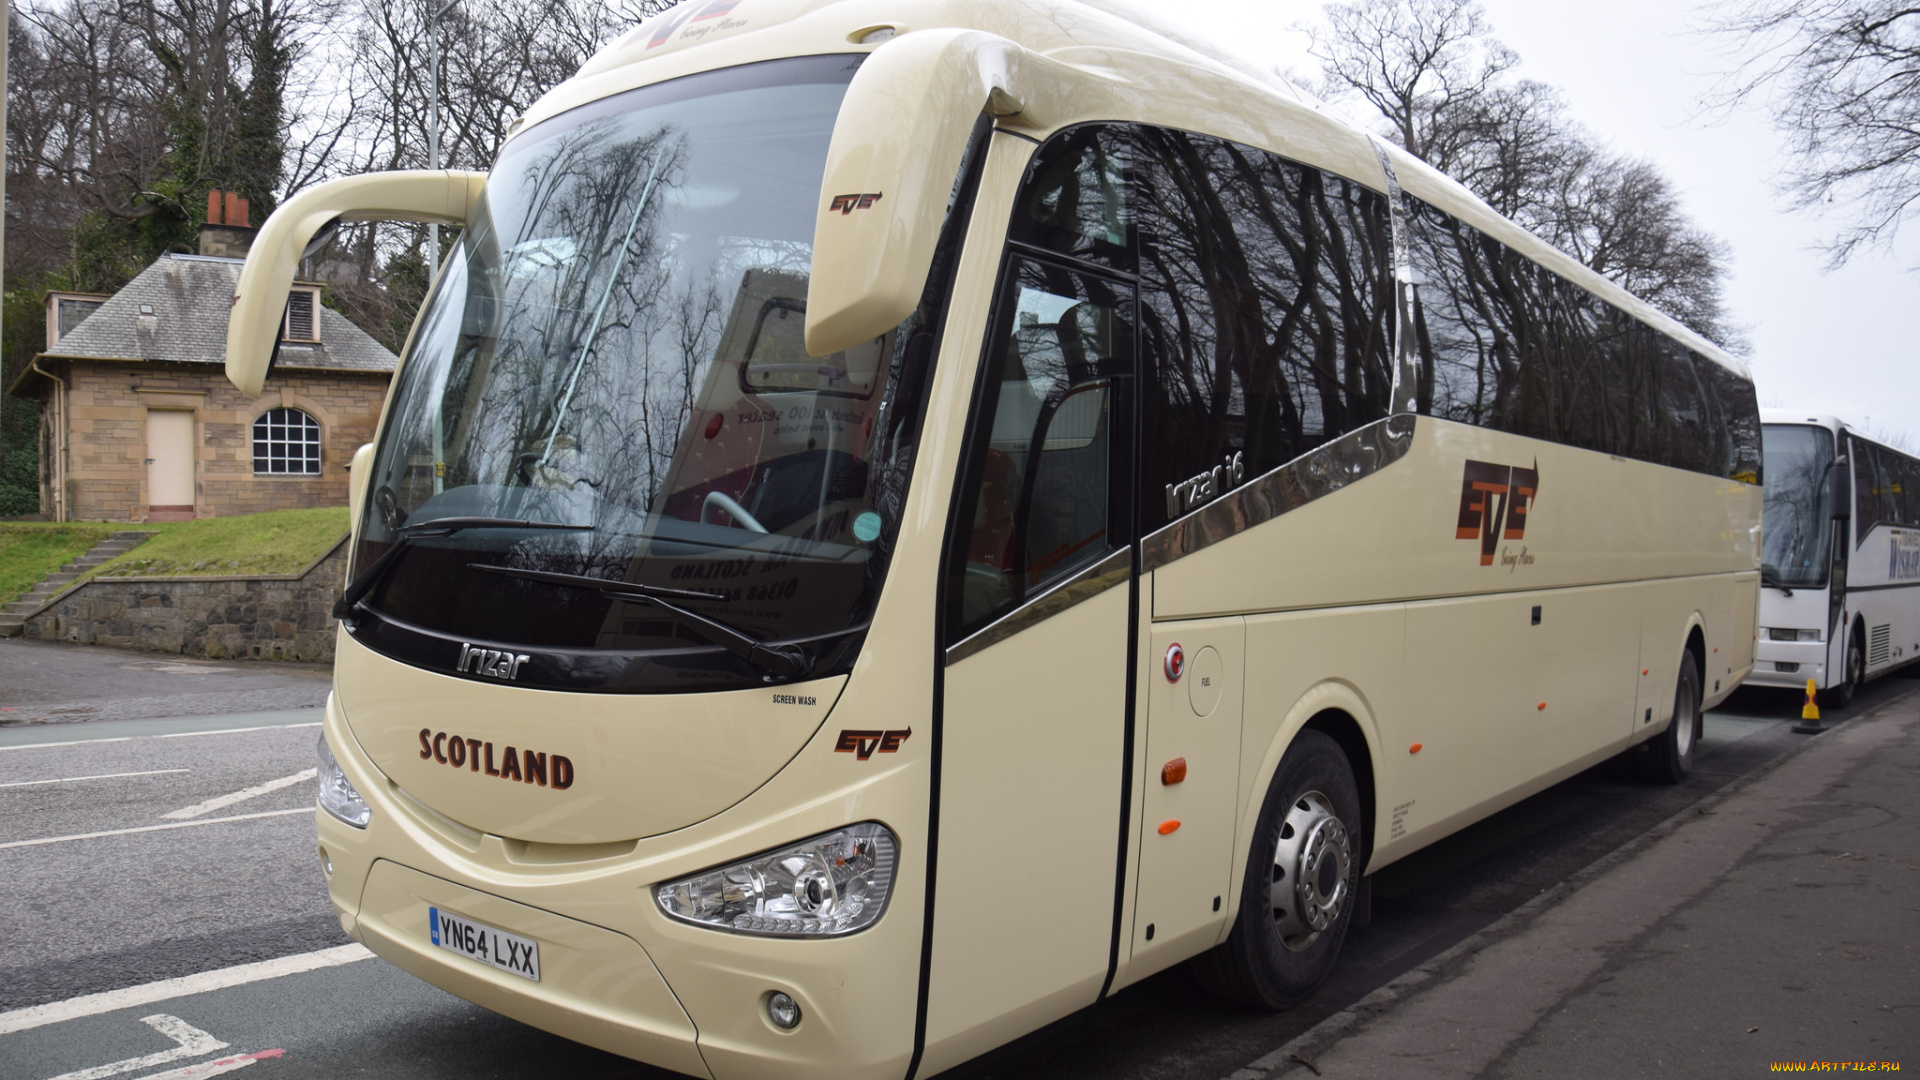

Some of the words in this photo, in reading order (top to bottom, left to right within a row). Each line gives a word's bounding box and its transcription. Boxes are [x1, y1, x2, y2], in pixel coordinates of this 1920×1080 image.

[829, 190, 883, 216] EVE
[1166, 465, 1222, 519] Irizar
[1225, 450, 1244, 489] i6
[1455, 455, 1539, 566] EVE
[457, 643, 530, 680] Irizar
[773, 694, 796, 705] SCREEN
[798, 696, 816, 706] WASH
[1202, 677, 1211, 686] FUEL
[419, 728, 574, 790] SCOTLAND
[834, 724, 912, 761] EVE
[440, 915, 488, 959] YN64
[493, 934, 535, 976] LXX
